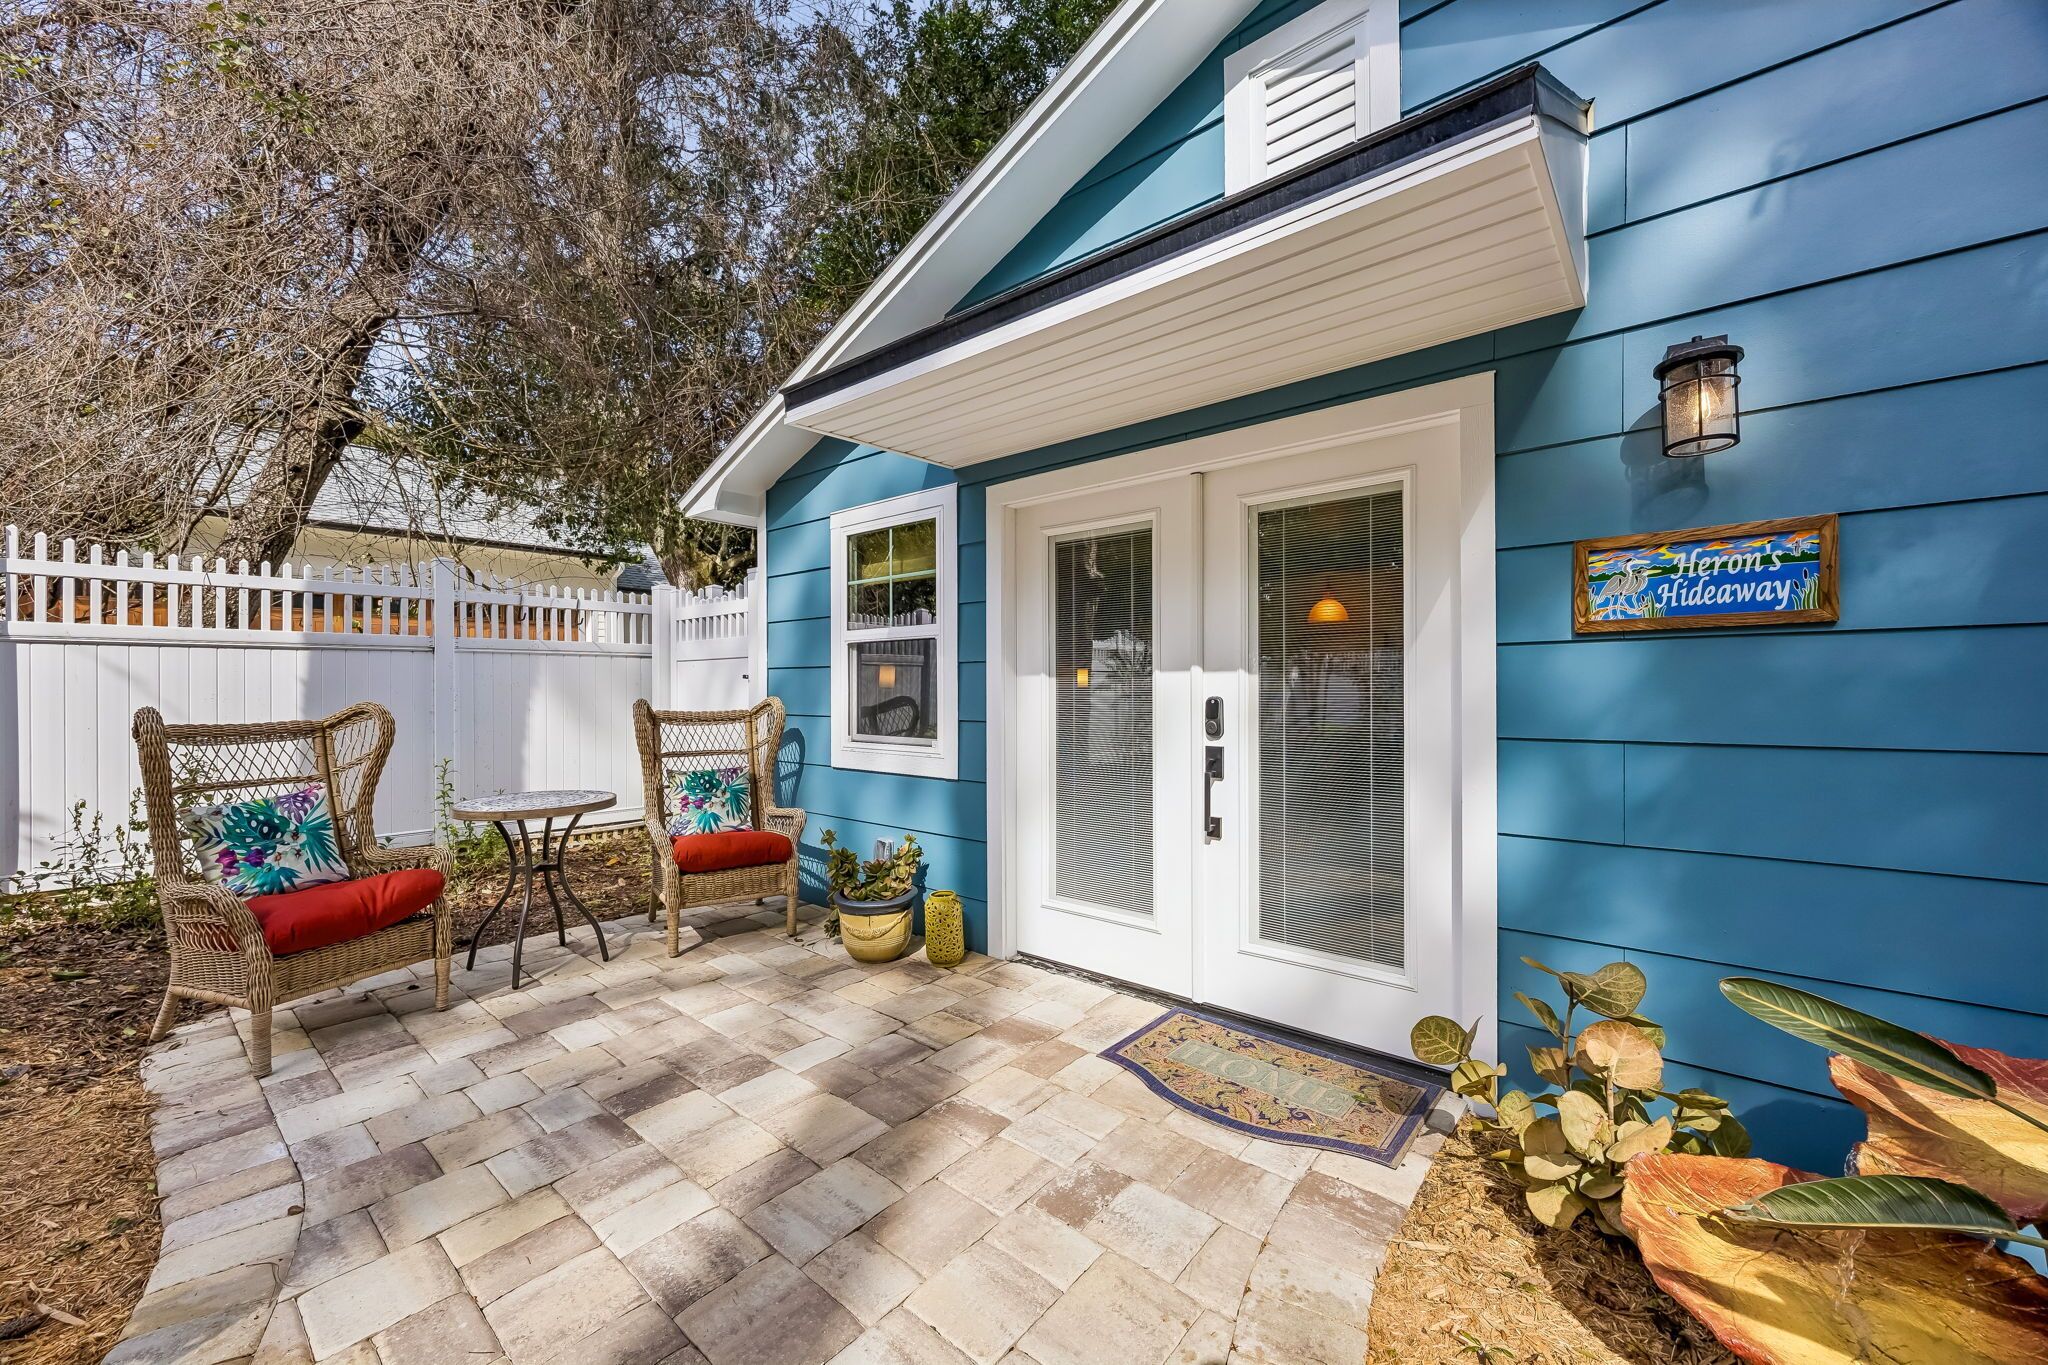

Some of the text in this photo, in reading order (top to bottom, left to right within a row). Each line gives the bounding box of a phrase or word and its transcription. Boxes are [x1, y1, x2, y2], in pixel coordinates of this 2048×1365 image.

[1671, 543, 1783, 579] Heron's
[1656, 577, 1792, 611] Hideaway
[1182, 1044, 1349, 1112] HOME
